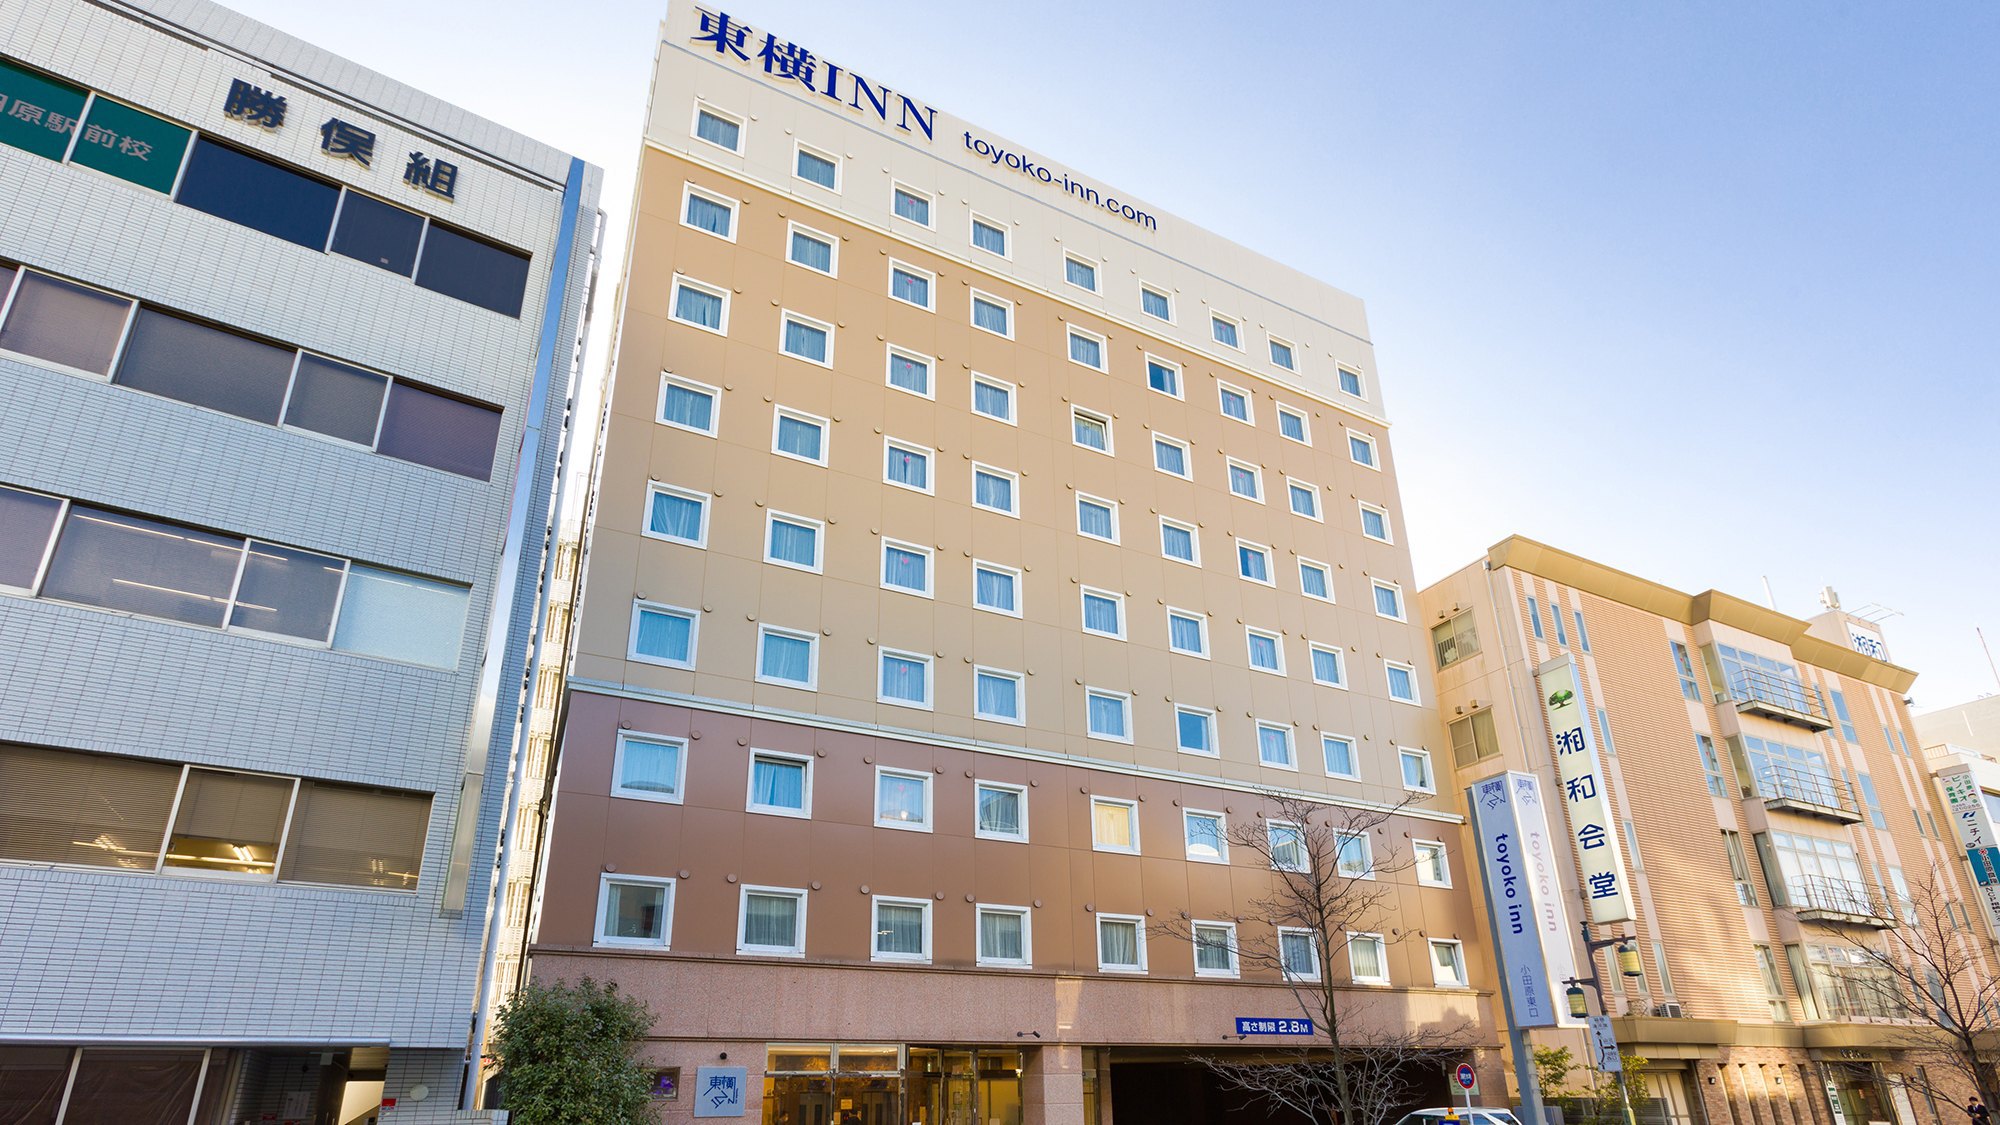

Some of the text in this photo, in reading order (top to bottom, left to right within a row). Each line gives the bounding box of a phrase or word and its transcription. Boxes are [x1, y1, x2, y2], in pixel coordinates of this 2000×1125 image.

[690, 5, 938, 142] 東横INN
[963, 130, 1158, 232] toyoko-inn.com
[1555, 726, 1619, 900] 湘和会堂
[1495, 833, 1524, 935] toyoko inn
[1530, 831, 1558, 932] toyoko inn
[1241, 1021, 1276, 1033] 高さ制限
